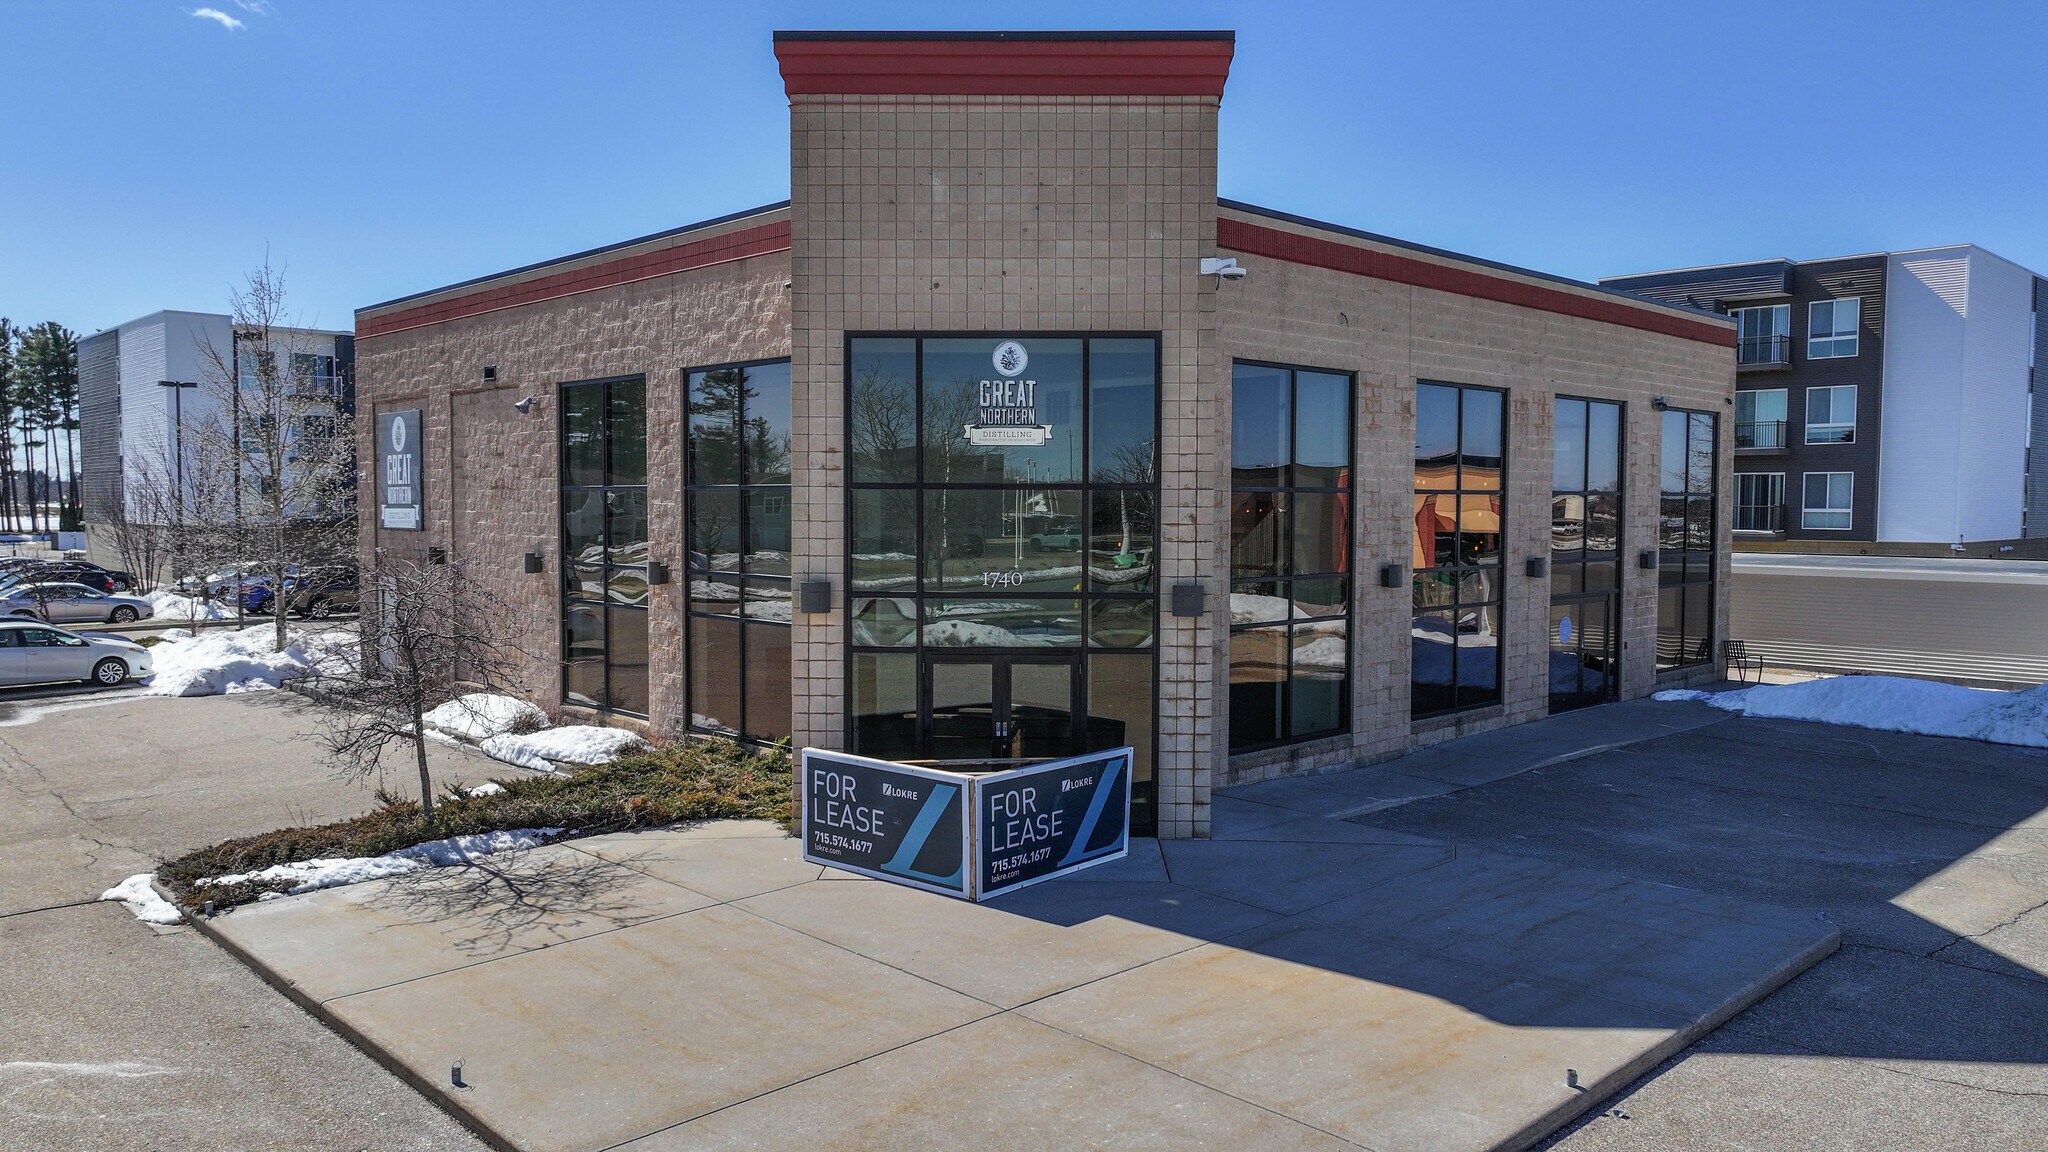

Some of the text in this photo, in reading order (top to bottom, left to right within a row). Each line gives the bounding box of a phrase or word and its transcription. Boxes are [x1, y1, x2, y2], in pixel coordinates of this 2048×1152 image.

[980, 380, 1037, 408] GREAT
[980, 408, 1036, 425] NORTHERN
[387, 453, 412, 485] GREAT
[982, 571, 1023, 588] 1740
[814, 769, 857, 802] FOR
[892, 786, 918, 801] LOKRE
[1071, 776, 1093, 790] LOKRE
[814, 797, 885, 837] LEASE
[991, 786, 1037, 823] FOR
[814, 830, 873, 854] 715.574.1677
[991, 809, 1064, 853] LEASE
[814, 842, 842, 856] lokre.com
[991, 846, 1051, 874] 715.574.1677
[991, 868, 1020, 883] lokre.com
